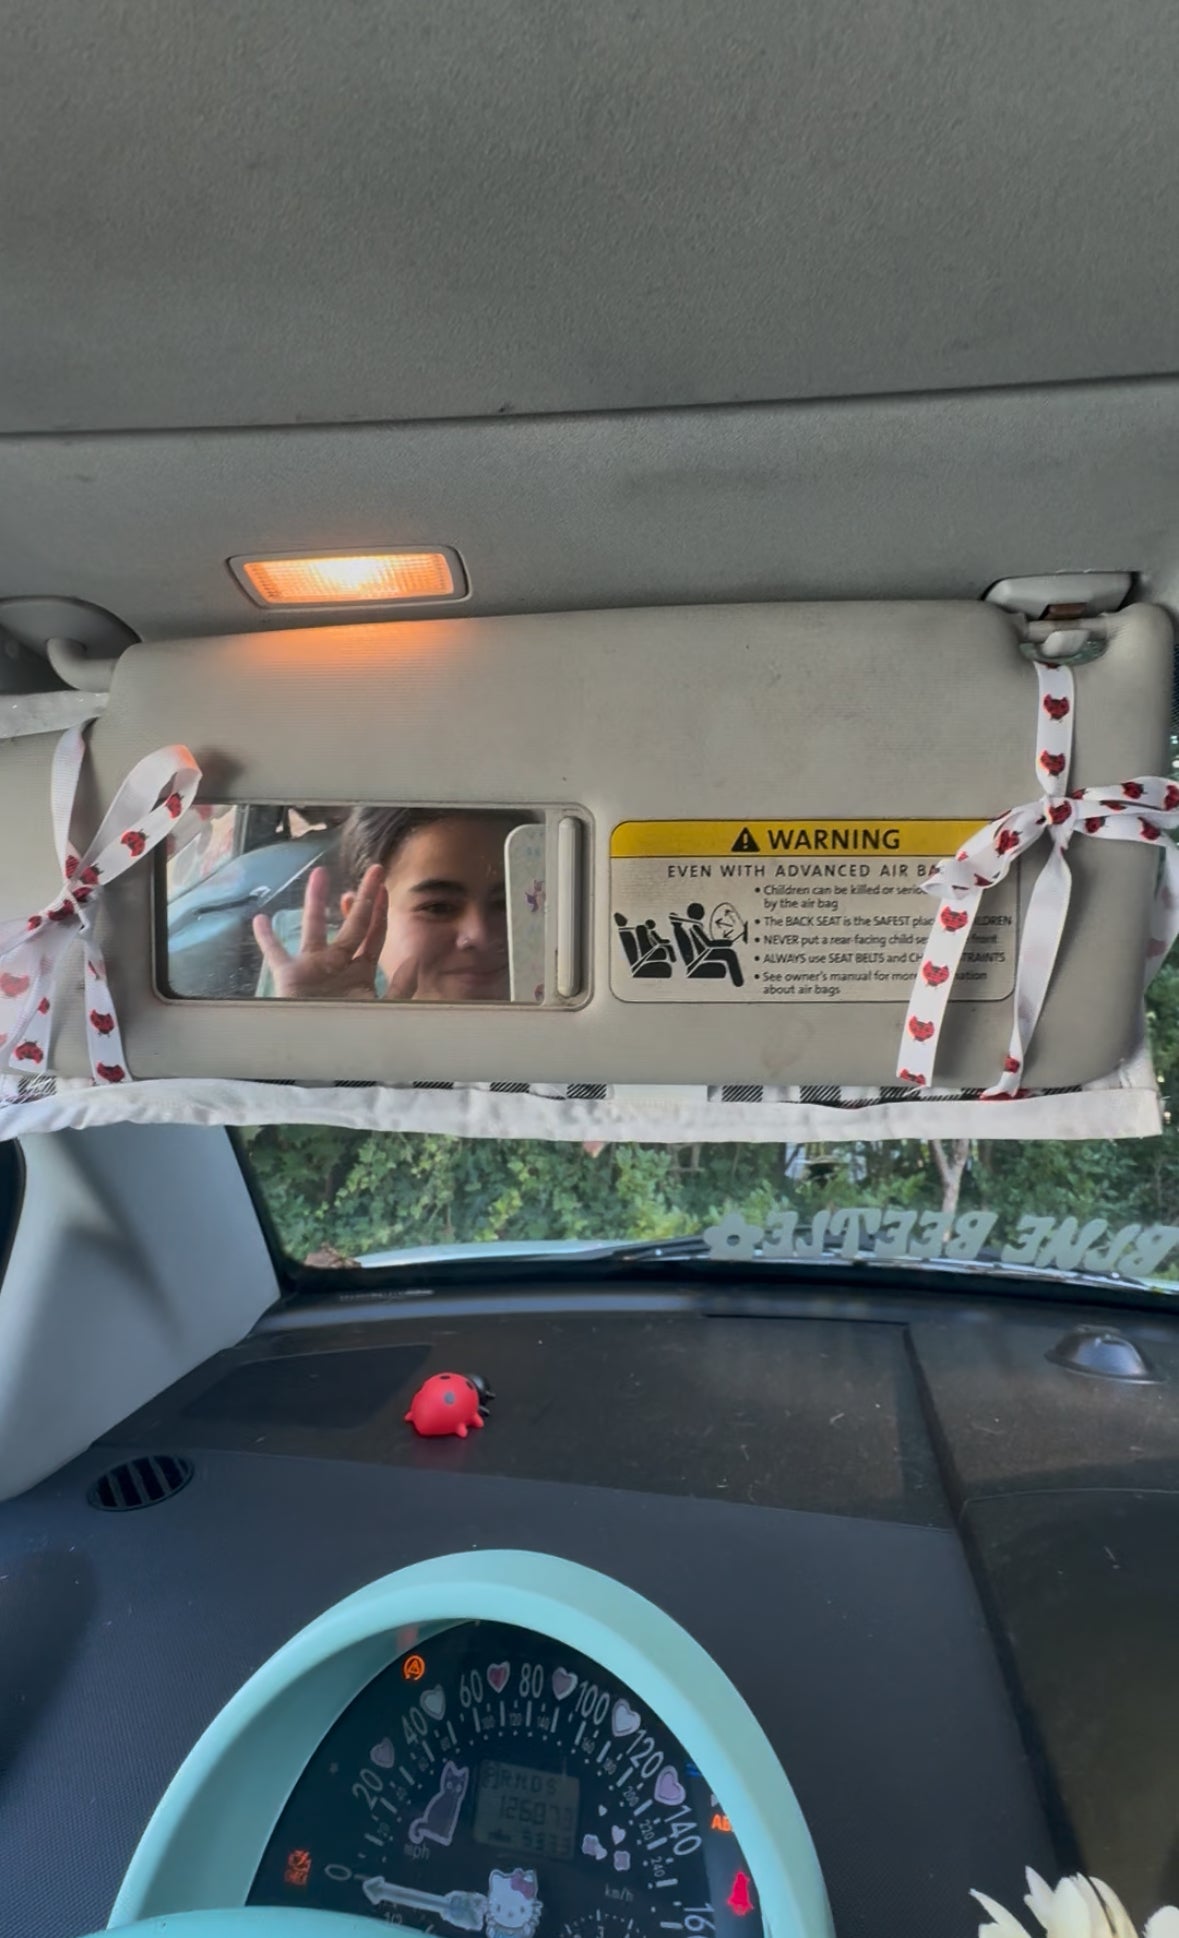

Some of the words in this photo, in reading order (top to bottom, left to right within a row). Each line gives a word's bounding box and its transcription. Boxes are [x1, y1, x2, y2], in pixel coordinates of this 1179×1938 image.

[767, 829, 900, 850] WARNING
[667, 864, 712, 878] EVEN
[720, 864, 766, 877] WITH
[774, 864, 871, 877] ADVANCED
[880, 864, 909, 877] AIR
[917, 864, 937, 877] BA
[763, 884, 810, 895] Children
[812, 887, 832, 895] can
[834, 885, 848, 895] be
[850, 884, 881, 895] killed
[882, 886, 894, 895] or
[896, 884, 928, 895] serio
[763, 898, 777, 912] by
[779, 898, 799, 908] the
[800, 898, 815, 908] air
[817, 898, 839, 912] bag
[764, 916, 783, 926] The
[785, 915, 814, 926] BACK
[816, 915, 842, 926] SEAT
[843, 916, 852, 926] is
[853, 916, 871, 926] the
[873, 915, 911, 926] SAFEST
[912, 916, 935, 928] plac
[764, 934, 800, 945] NEVER
[801, 935, 820, 947] put
[821, 937, 829, 945] a
[830, 934, 887, 948] rear-facing
[888, 934, 914, 944] child
[915, 936, 929, 944] se
[763, 953, 807, 964] ALWAYS
[808, 955, 826, 963] use
[828, 952, 853, 963] SEAT
[855, 953, 885, 964] BELTS
[886, 953, 907, 963] and
[763, 971, 783, 981] See
[784, 970, 828, 981] owner's
[830, 970, 872, 981] manual
[873, 970, 889, 981] for
[891, 973, 918, 981] mor
[763, 984, 795, 995] about
[797, 984, 813, 995] air
[815, 984, 841, 997] bags
[459, 1669, 484, 1708] 60
[518, 1662, 545, 1699] 80
[574, 1680, 611, 1726] 100
[401, 1707, 428, 1745] 40
[625, 1728, 664, 1778] 120
[351, 1768, 384, 1811] 20
[664, 1804, 703, 1856] 140
[711, 1814, 733, 1832] AB
[323, 1863, 352, 1882] 0
[650, 1855, 666, 1878] 240
[604, 1883, 635, 1903] km/h
[683, 1902, 717, 1938] 16
